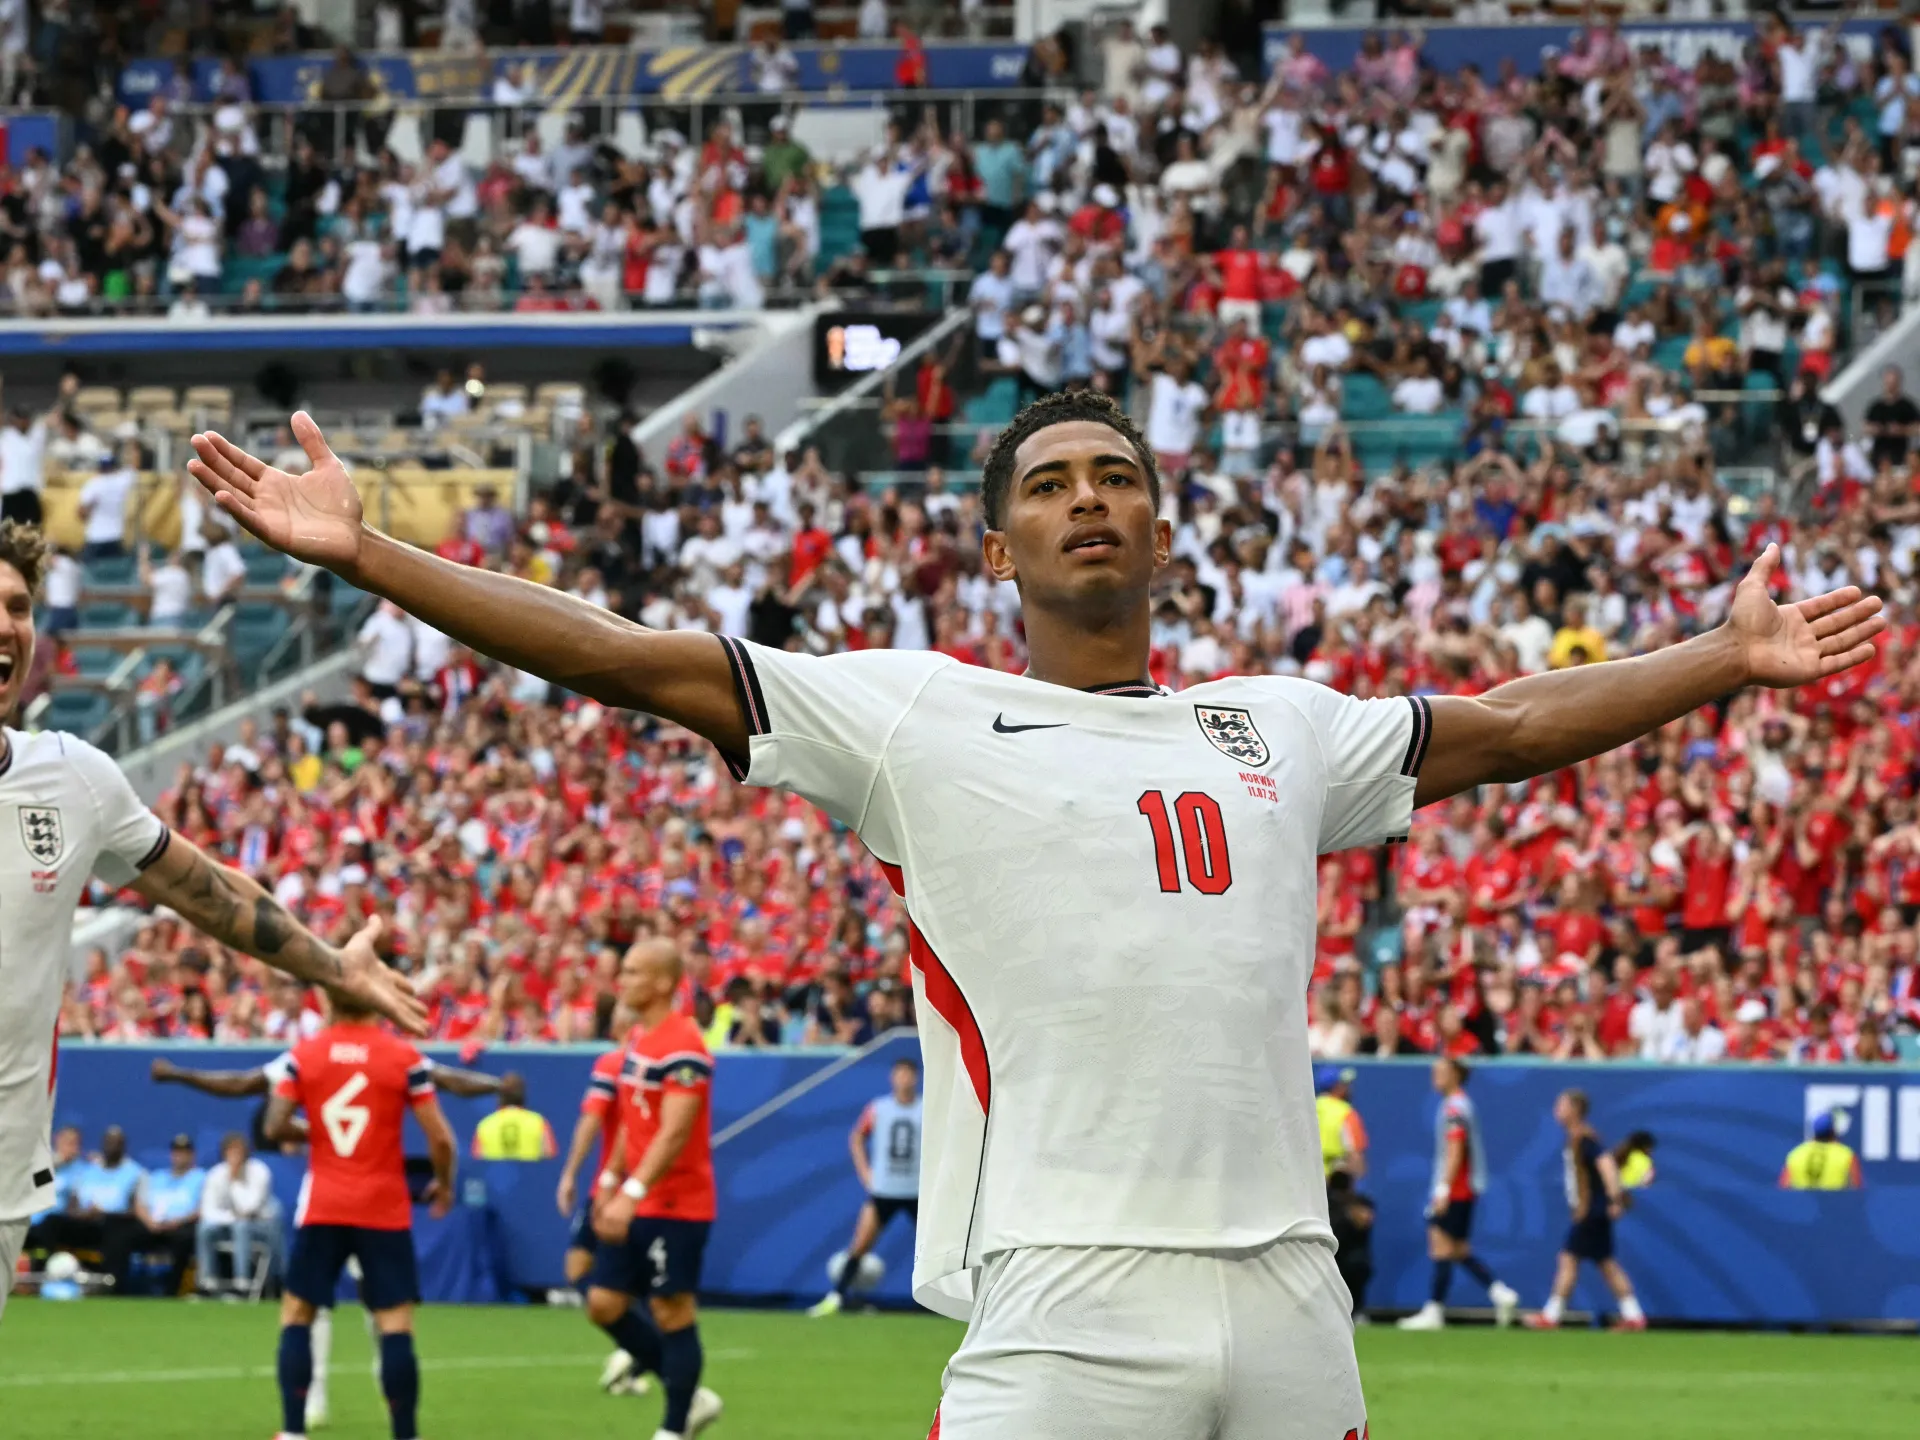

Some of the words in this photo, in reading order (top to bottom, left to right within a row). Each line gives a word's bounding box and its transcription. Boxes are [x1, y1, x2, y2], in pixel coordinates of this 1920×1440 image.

[1238, 772, 1277, 789] NORWAY
[1137, 790, 1233, 895] 10
[321, 1071, 370, 1157] 6
